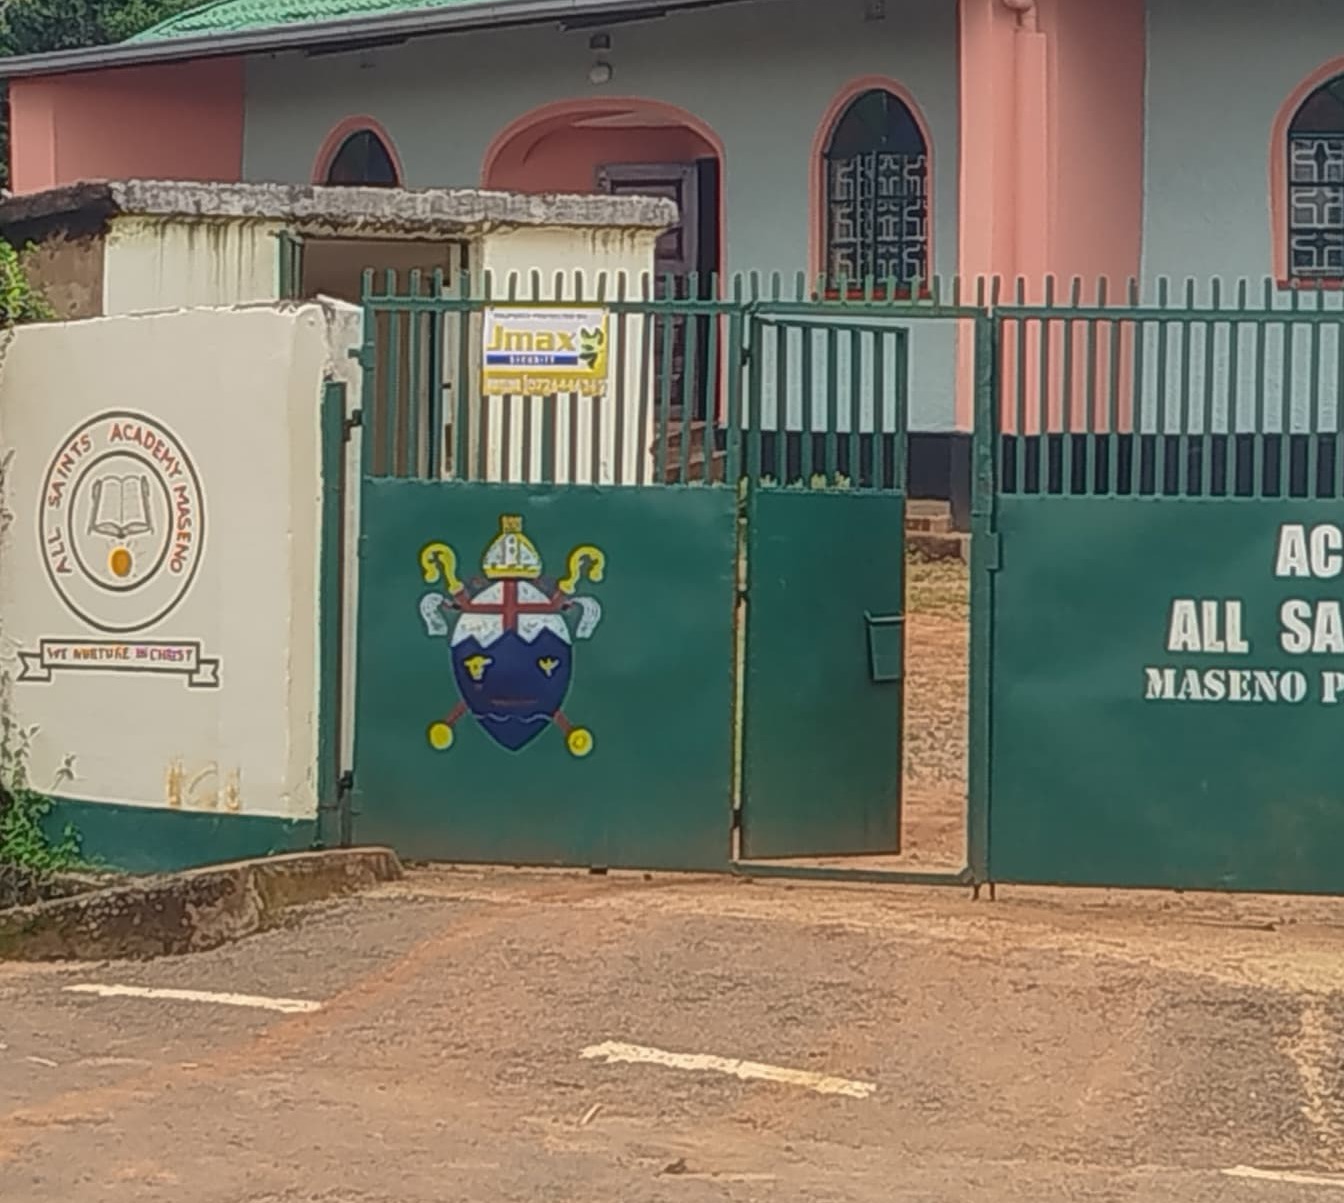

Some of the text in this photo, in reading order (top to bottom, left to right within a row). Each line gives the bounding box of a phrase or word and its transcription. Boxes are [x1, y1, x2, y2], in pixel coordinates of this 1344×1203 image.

[487, 324, 577, 351] Jmax
[48, 422, 193, 575] ALL SAINTS ACADEMY MASENO
[1167, 599, 1249, 654] ALL
[47, 647, 193, 662] WE NURTURE IN CHRIST
[1145, 667, 1307, 703] MASENO
